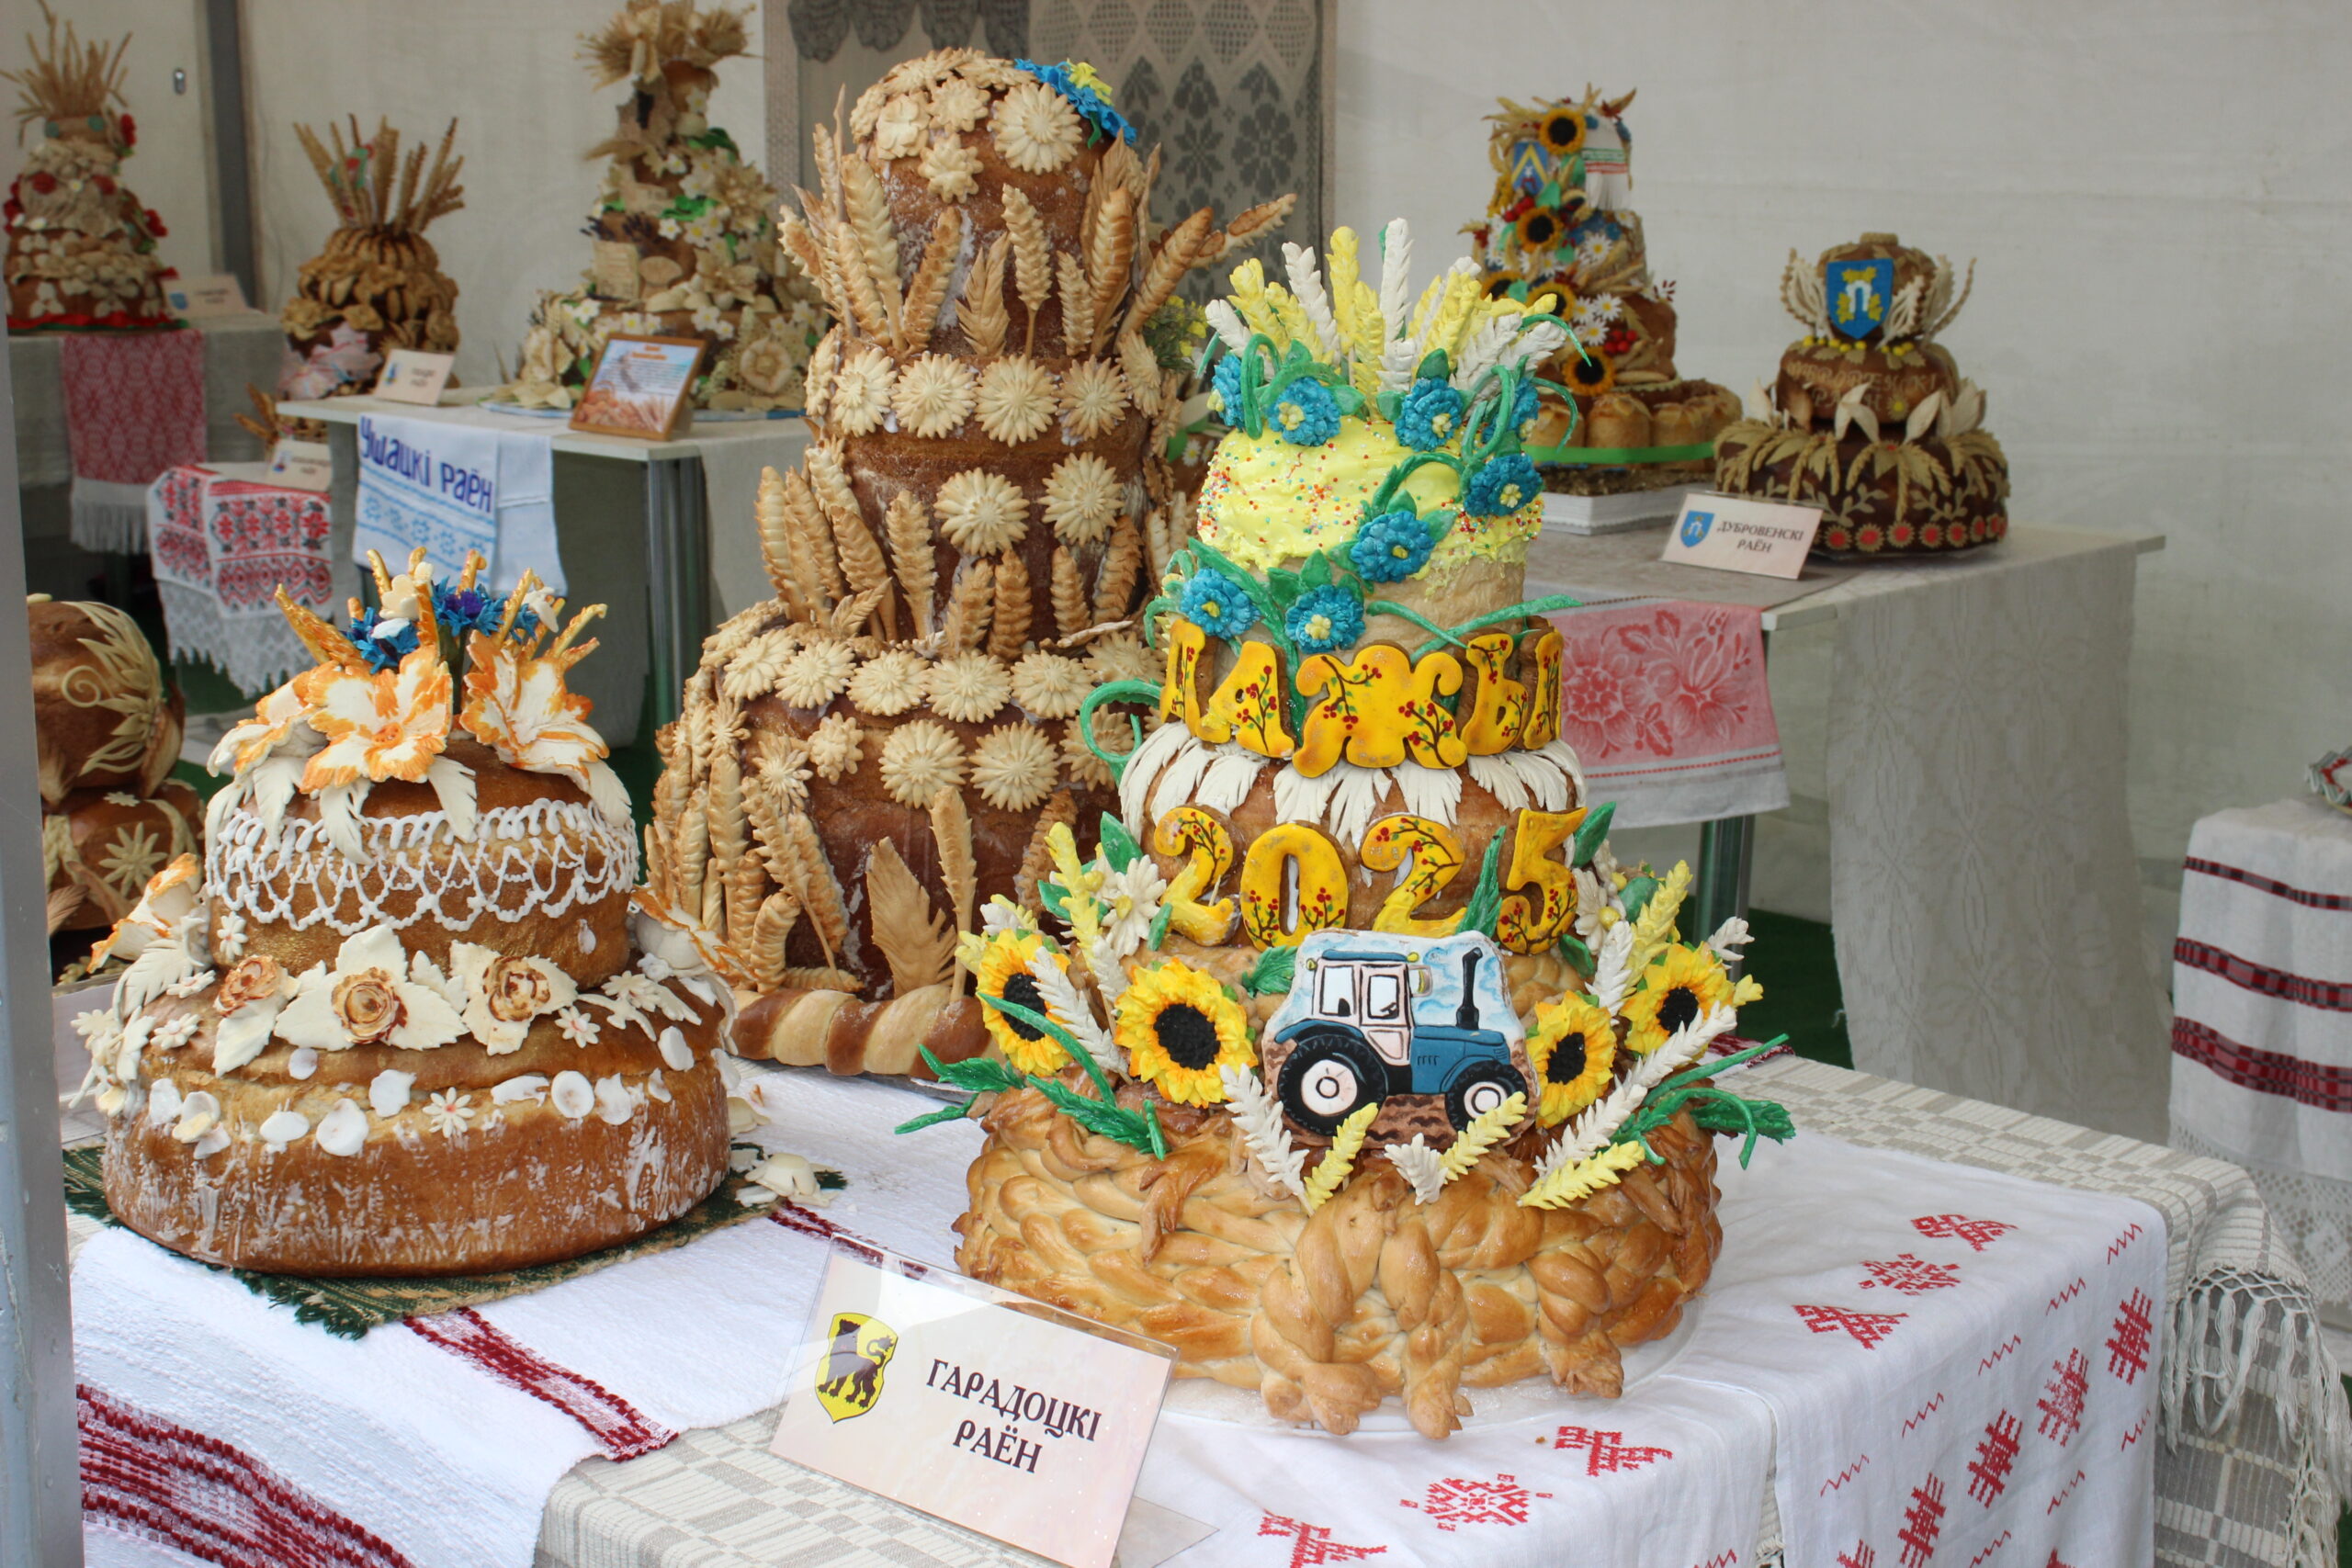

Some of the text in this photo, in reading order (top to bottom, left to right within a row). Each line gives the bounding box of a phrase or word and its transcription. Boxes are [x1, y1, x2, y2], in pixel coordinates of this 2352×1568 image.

[1812, 387, 1884, 412] РАН
[361, 416, 432, 488] Ушацкі
[1717, 520, 1804, 542] ДУБРОВЕНСКІ
[1736, 538, 1774, 554] РАЁН
[1159, 618, 1565, 778] ДАЖЫ
[1153, 806, 1589, 954] 2025
[925, 1358, 1102, 1442] ГАРАДОЦКІ
[952, 1419, 1044, 1474] РАЁН
